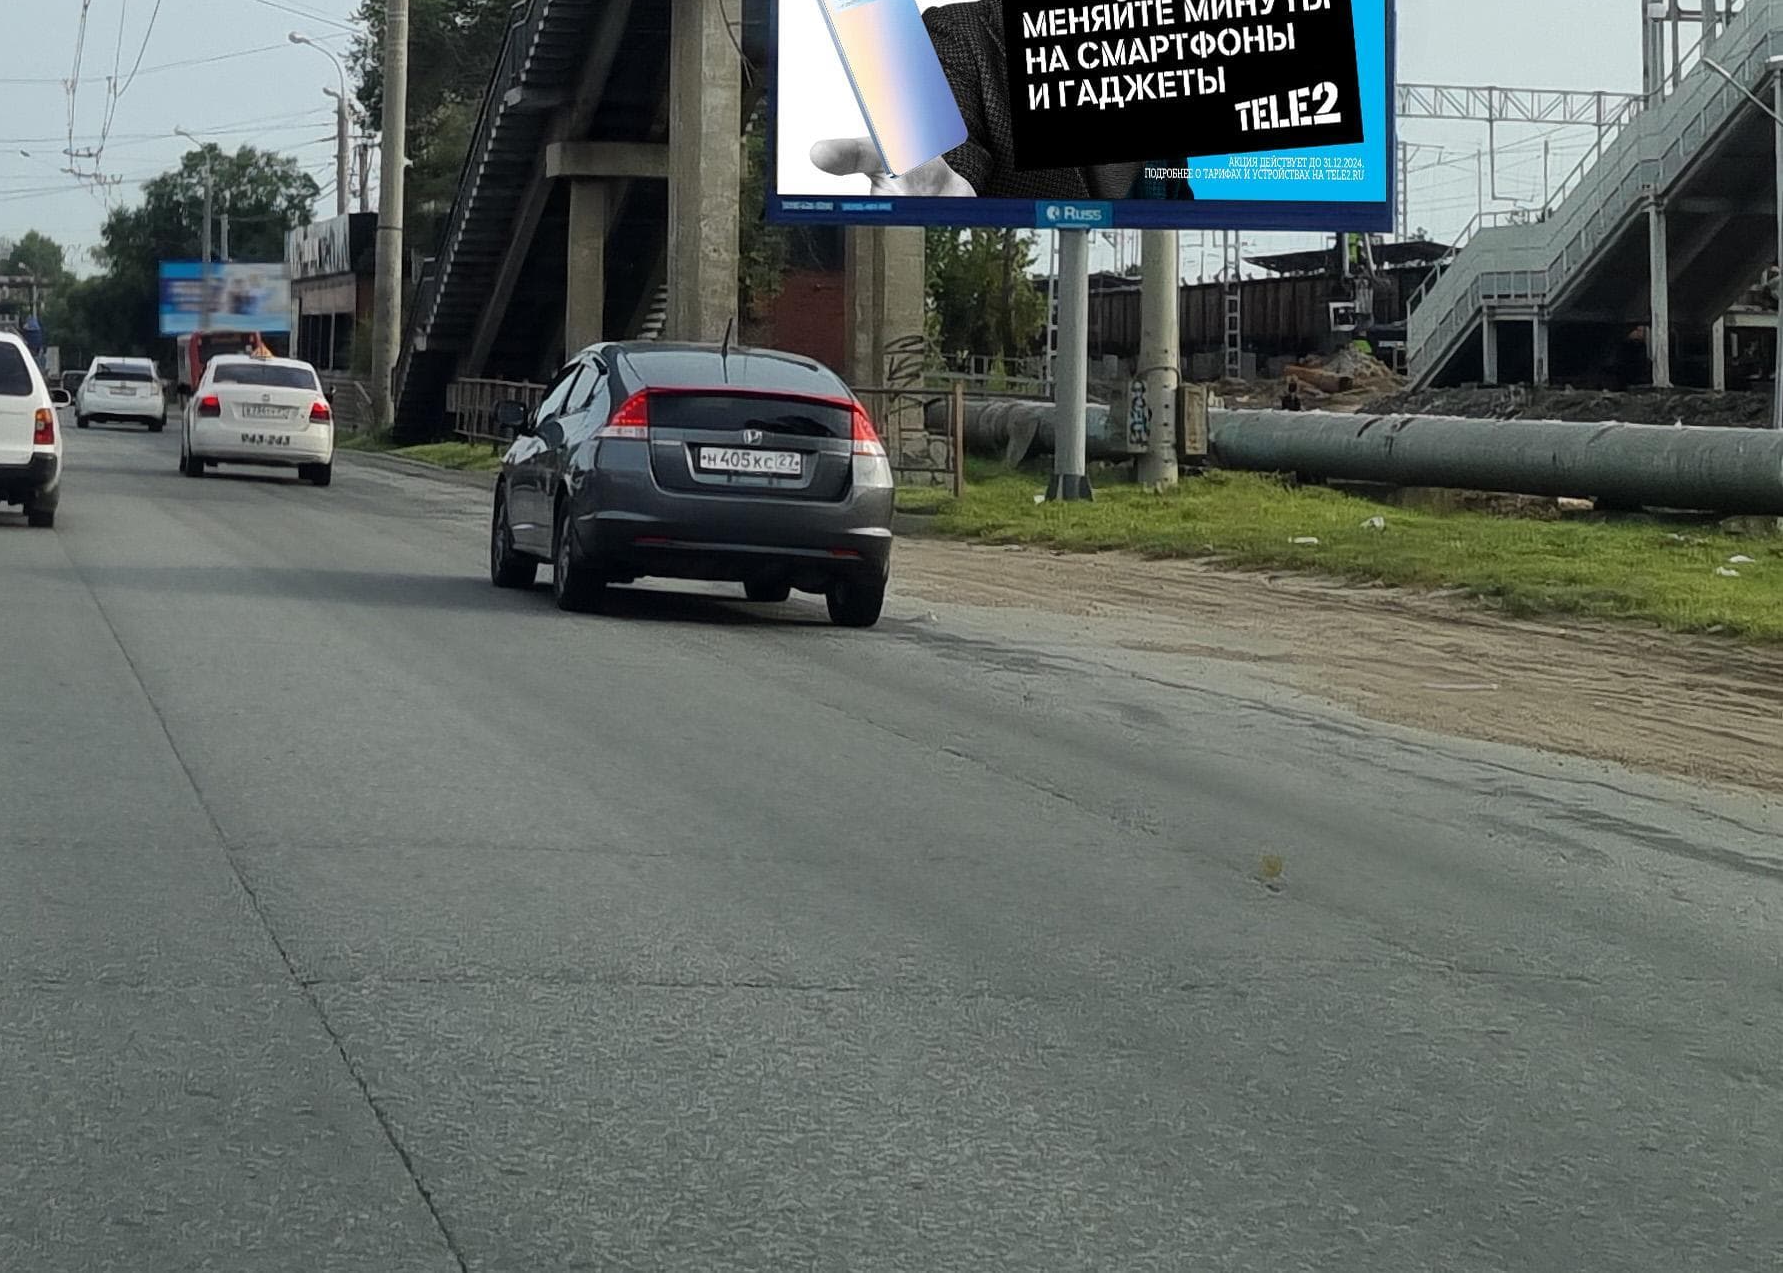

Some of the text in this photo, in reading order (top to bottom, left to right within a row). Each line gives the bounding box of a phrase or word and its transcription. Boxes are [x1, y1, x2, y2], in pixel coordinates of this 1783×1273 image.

[1025, 23, 1296, 75] НА СМАРТФОНЫ
[1028, 66, 1226, 111] И ГАДЖЕТЫ
[1234, 81, 1342, 132] TELE2
[1144, 167, 1365, 180] ПОДРОБНЕЕ О ТАРИФАХ И УСТРОЙСТВАХ НА TELE2.RU
[1228, 157, 1257, 168] АКЦИЯ
[1260, 155, 1308, 168] ДЕЙСТВУЕТ
[1309, 157, 1322, 169] ДО
[1064, 206, 1103, 221] Russ
